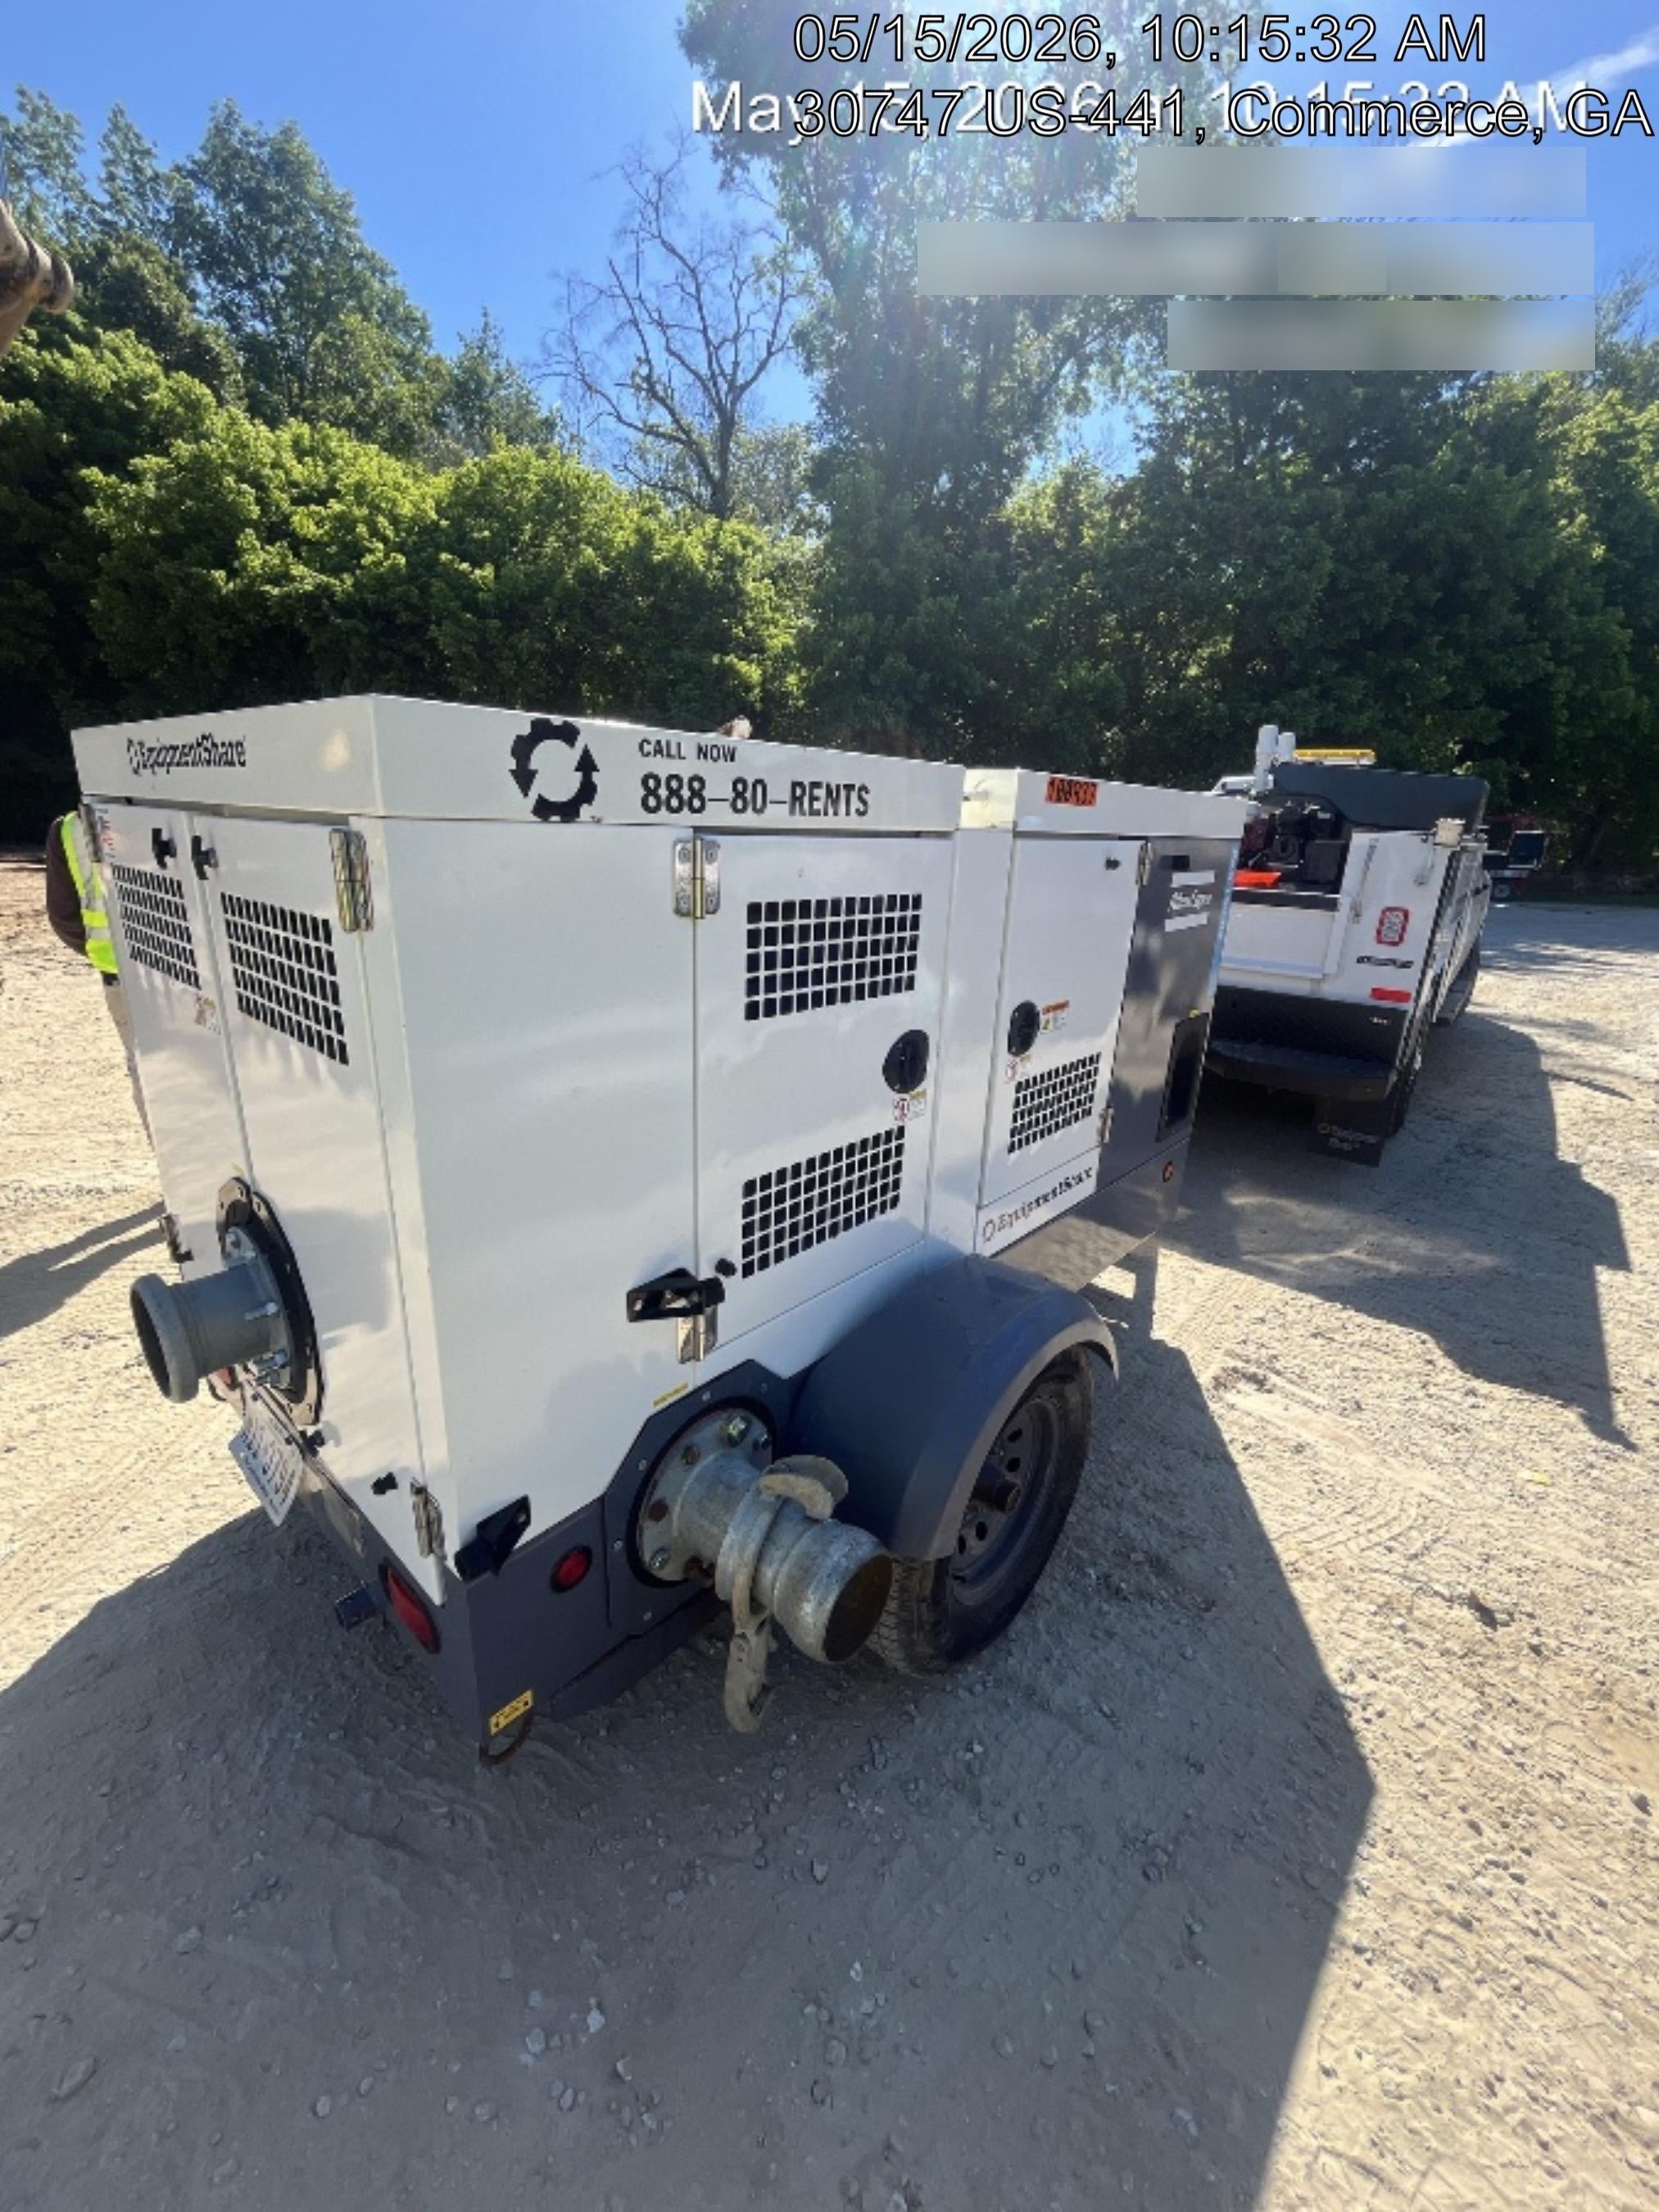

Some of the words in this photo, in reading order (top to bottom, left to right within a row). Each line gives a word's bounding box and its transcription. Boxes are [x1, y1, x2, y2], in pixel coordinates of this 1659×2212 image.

[638, 738, 687, 760] CALL
[696, 741, 737, 763] NOW
[640, 772, 871, 818] 888-80-RENTS
